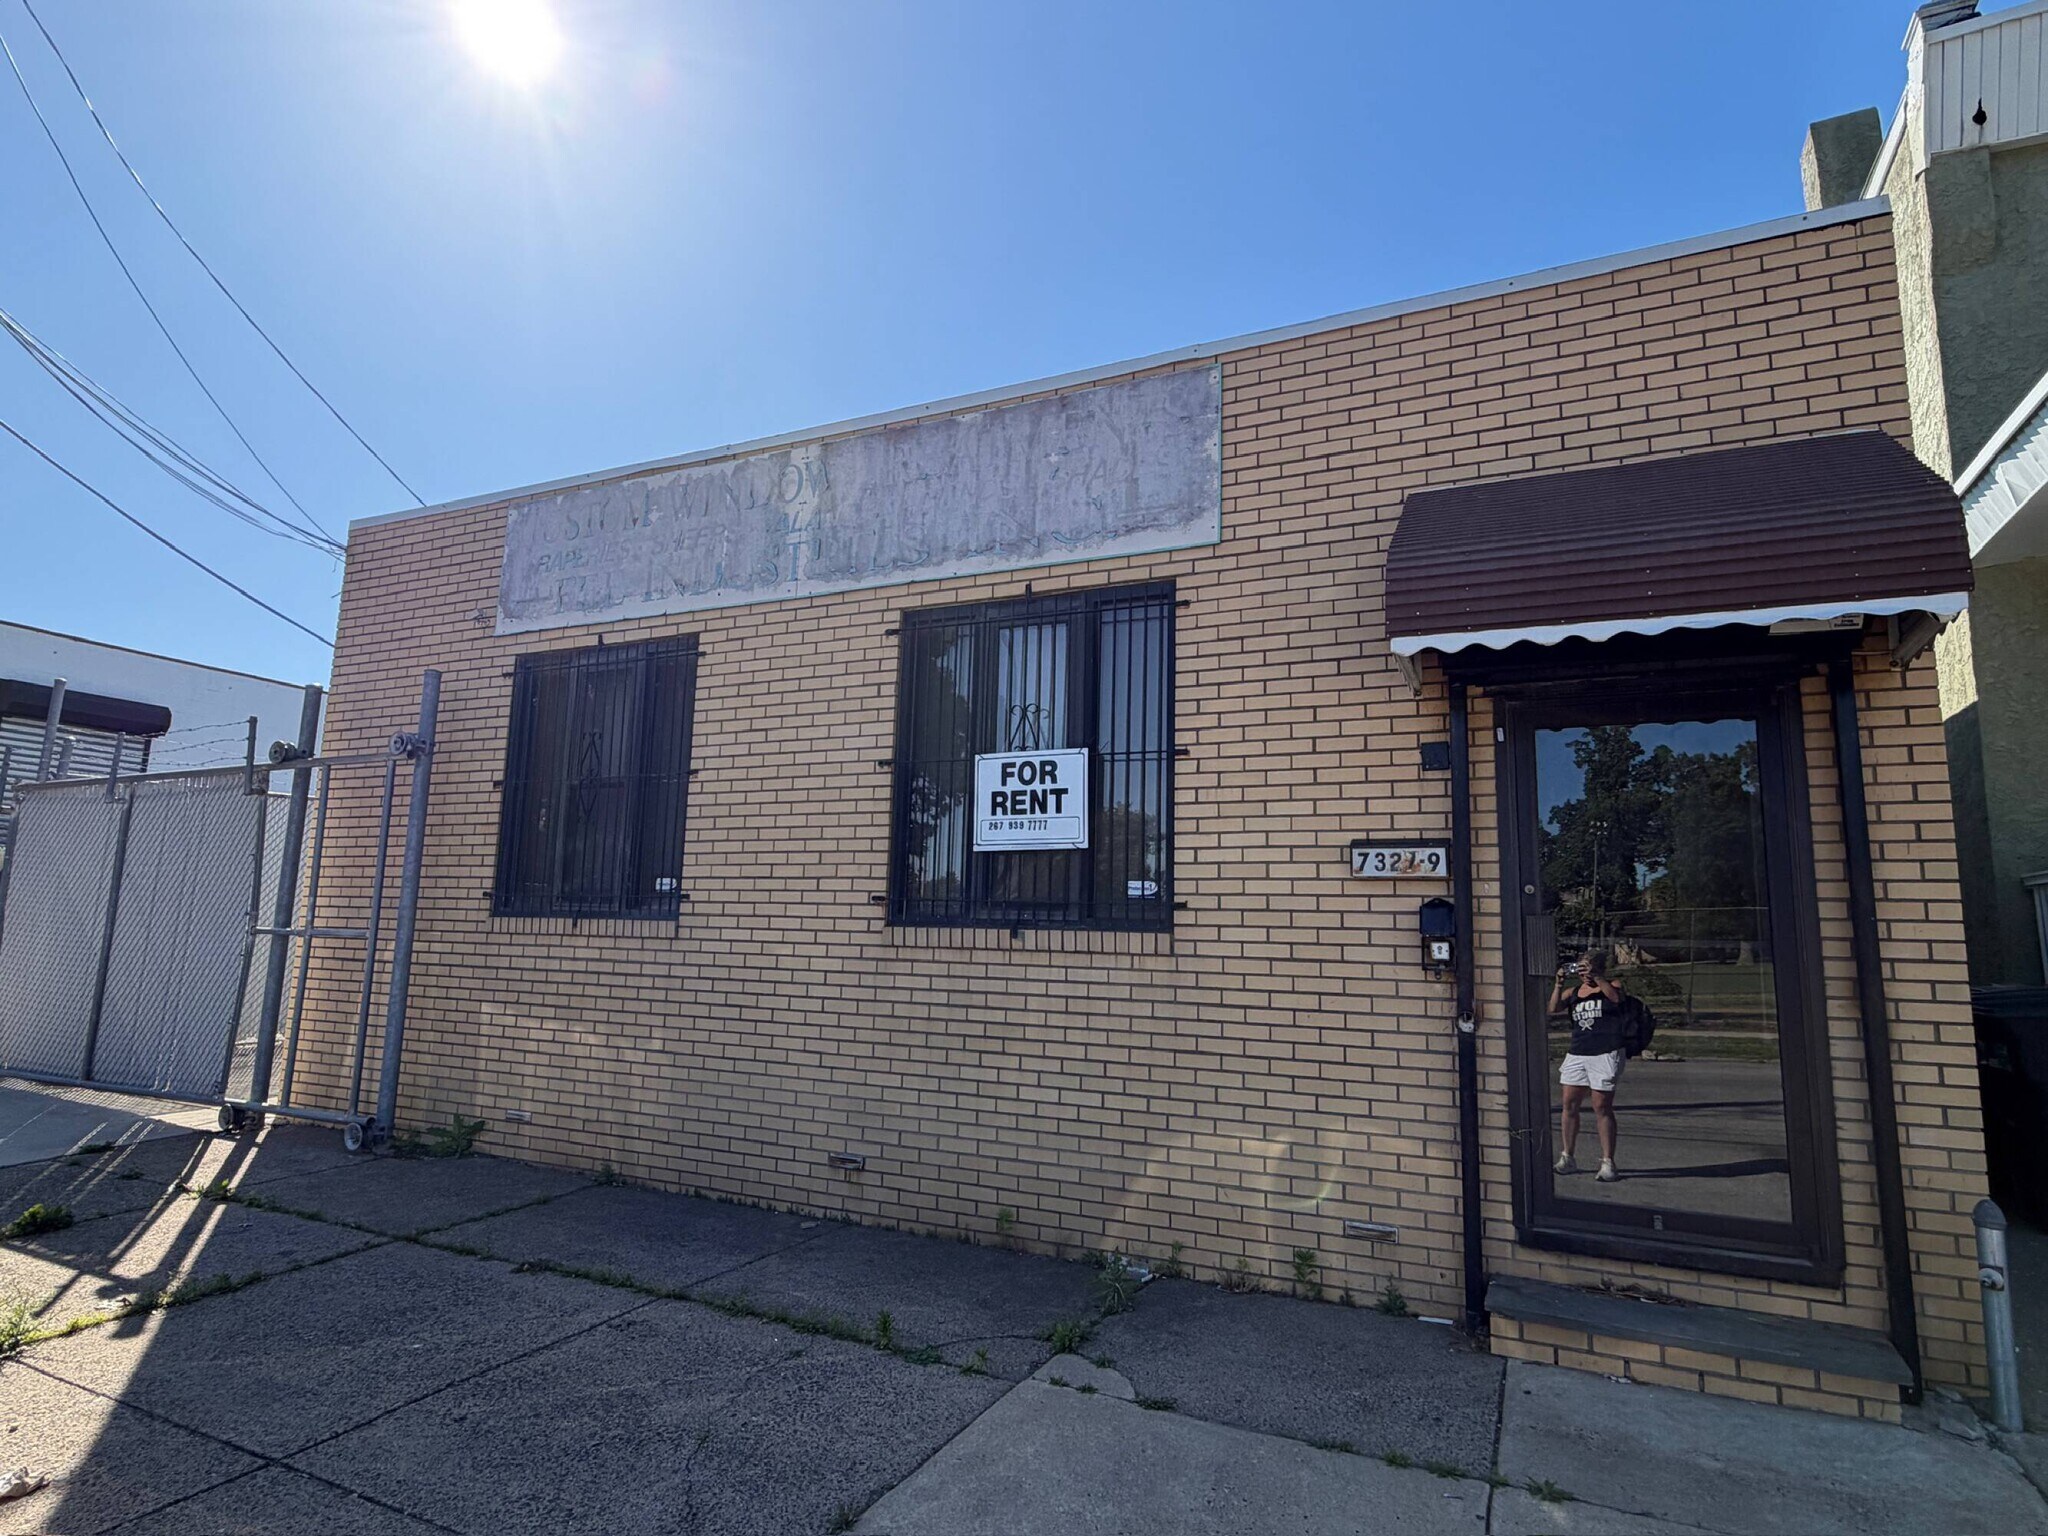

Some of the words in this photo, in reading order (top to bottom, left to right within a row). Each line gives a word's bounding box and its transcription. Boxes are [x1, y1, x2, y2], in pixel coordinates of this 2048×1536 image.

[1001, 760, 1058, 786] FOR
[991, 788, 1069, 816] RENT
[988, 821, 1003, 831] 267
[1027, 820, 1048, 831] 7777
